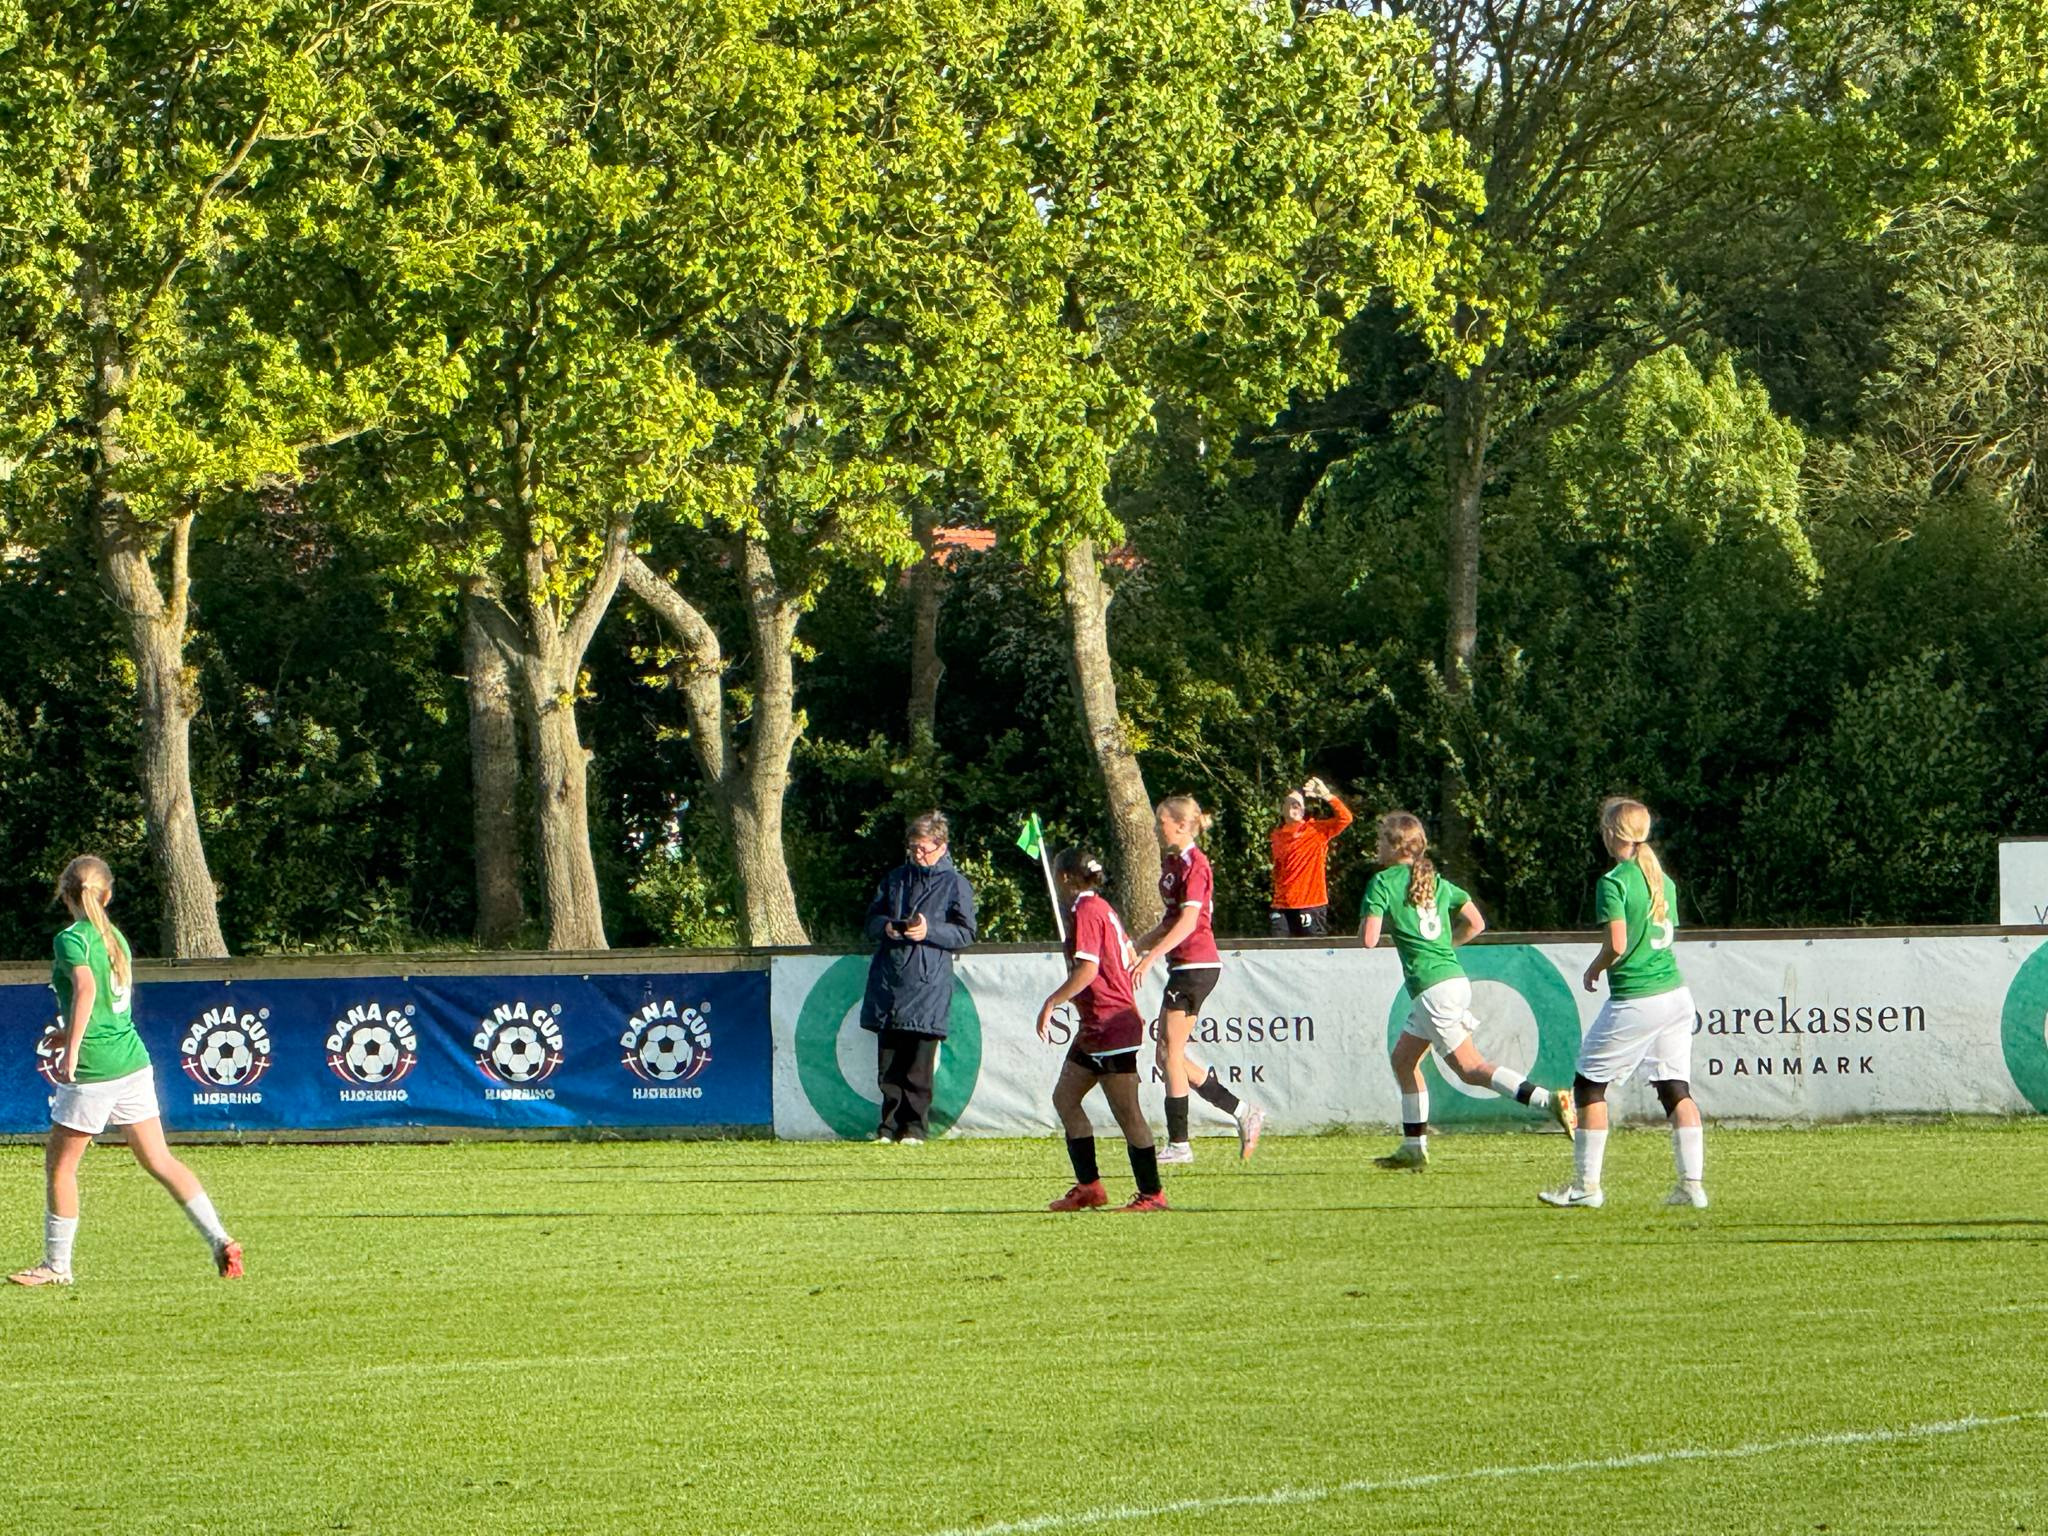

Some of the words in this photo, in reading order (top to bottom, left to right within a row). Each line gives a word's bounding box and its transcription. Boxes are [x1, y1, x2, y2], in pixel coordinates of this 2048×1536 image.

[182, 1006, 236, 1055] DANA
[240, 1013, 271, 1055] CUP
[326, 1003, 382, 1052] DANA
[386, 1009, 417, 1052] CUP
[473, 1002, 528, 1050] DANA
[532, 1008, 564, 1051] CUP
[620, 1000, 678, 1049] DANA
[681, 1007, 712, 1050] CUP
[1691, 996, 1926, 1035] arekassen
[1709, 1055, 1874, 1076] DANMARK
